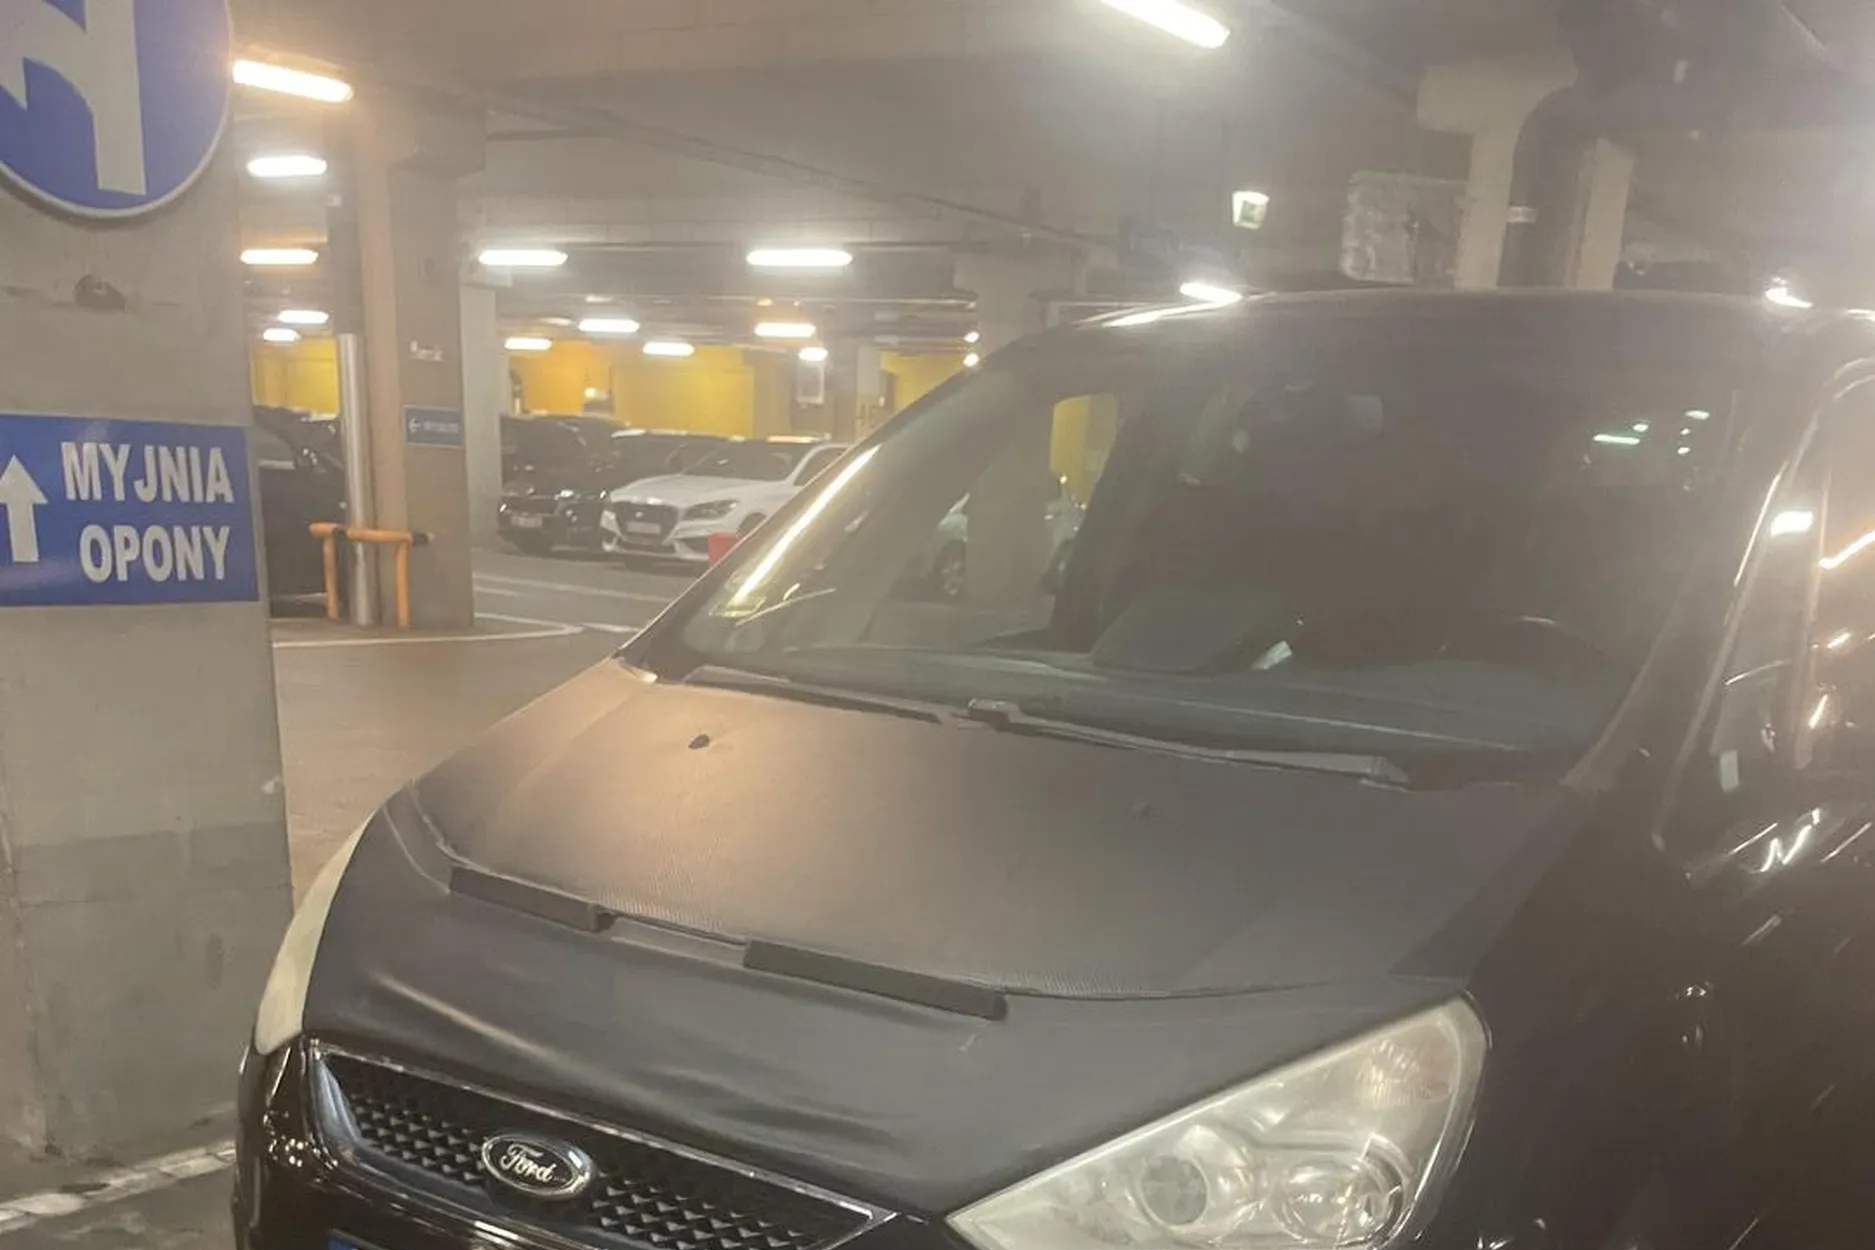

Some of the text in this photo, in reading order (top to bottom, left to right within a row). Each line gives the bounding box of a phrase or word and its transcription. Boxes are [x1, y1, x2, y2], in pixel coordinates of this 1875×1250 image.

[61, 441, 235, 503] MYJNIA
[80, 524, 230, 584] OPONY
[500, 1143, 557, 1183] Ford
